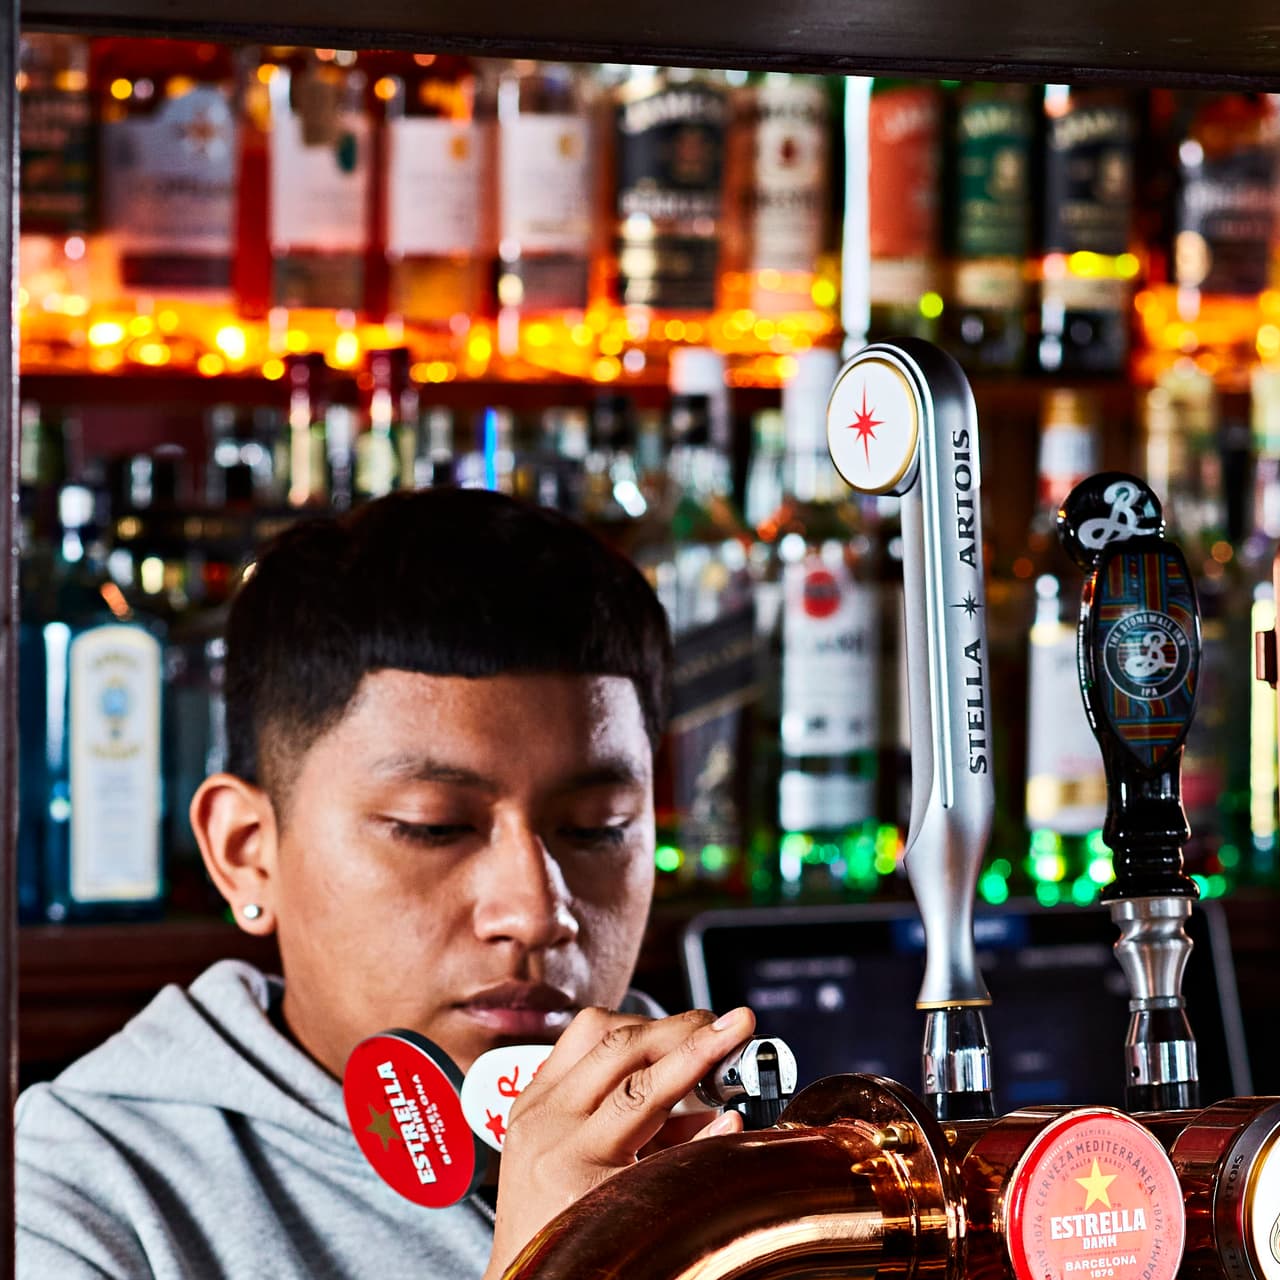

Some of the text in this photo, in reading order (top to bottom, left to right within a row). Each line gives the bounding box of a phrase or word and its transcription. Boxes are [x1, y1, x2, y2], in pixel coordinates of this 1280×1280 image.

[952, 428, 988, 775] STELLA ARTOIS
[1108, 629, 1122, 649] THE
[1122, 613, 1173, 633] STONEWALL
[1140, 686, 1159, 697] IPA
[376, 1061, 437, 1185] ESTRELLA
[406, 1099, 431, 1143] DAMM
[412, 1073, 452, 1165] BARCELONA
[1035, 1149, 1075, 1208] CERVEZA
[1075, 1139, 1157, 1196] MEDITERRÁNEA
[1050, 1208, 1148, 1240] ESTRELLA
[1083, 1234, 1118, 1250] DAMM
[1065, 1254, 1137, 1272] BARCELONA
[1089, 1268, 1115, 1279] 1876
